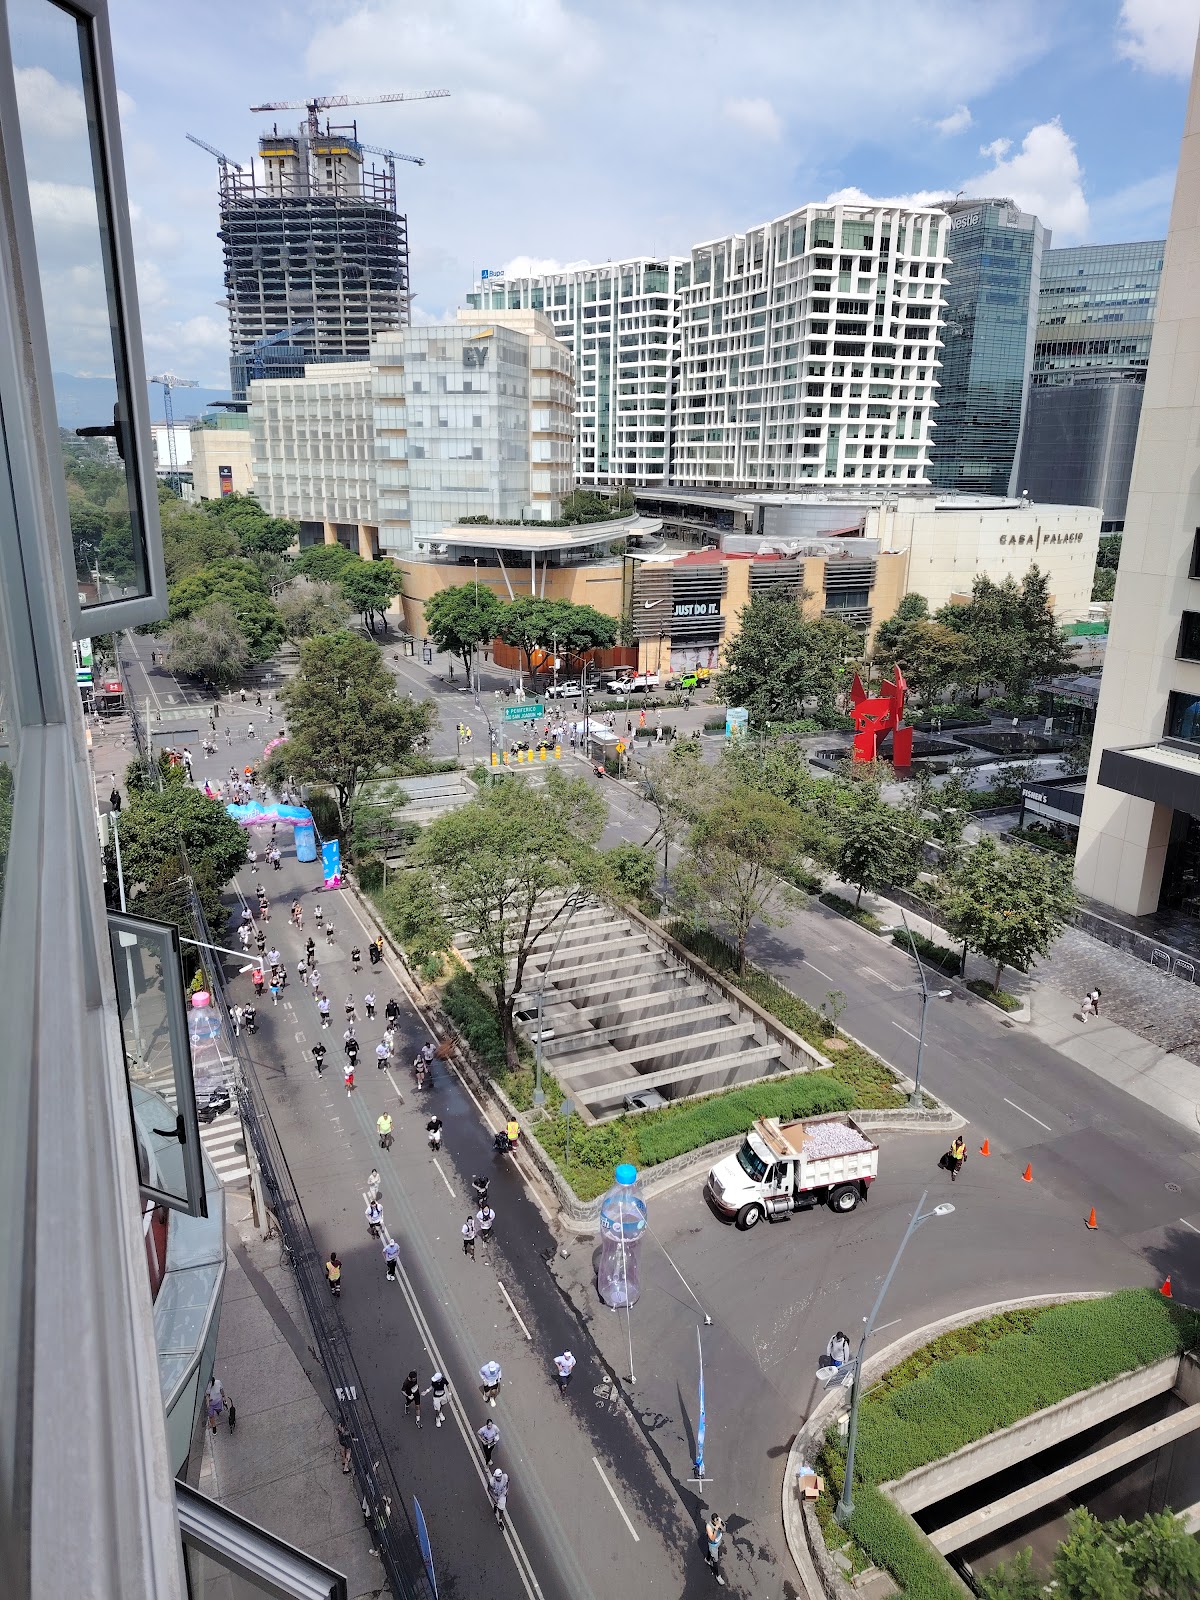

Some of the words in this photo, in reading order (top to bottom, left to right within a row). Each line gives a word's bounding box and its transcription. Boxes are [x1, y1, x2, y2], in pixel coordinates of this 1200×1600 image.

[462, 346, 489, 366] EY
[1000, 534, 1034, 546] CASA
[1043, 532, 1084, 545] PALACIO
[674, 604, 694, 616] JUST
[694, 603, 707, 615] DO
[708, 603, 719, 614] IT.
[1022, 788, 1048, 804] FISHER'S
